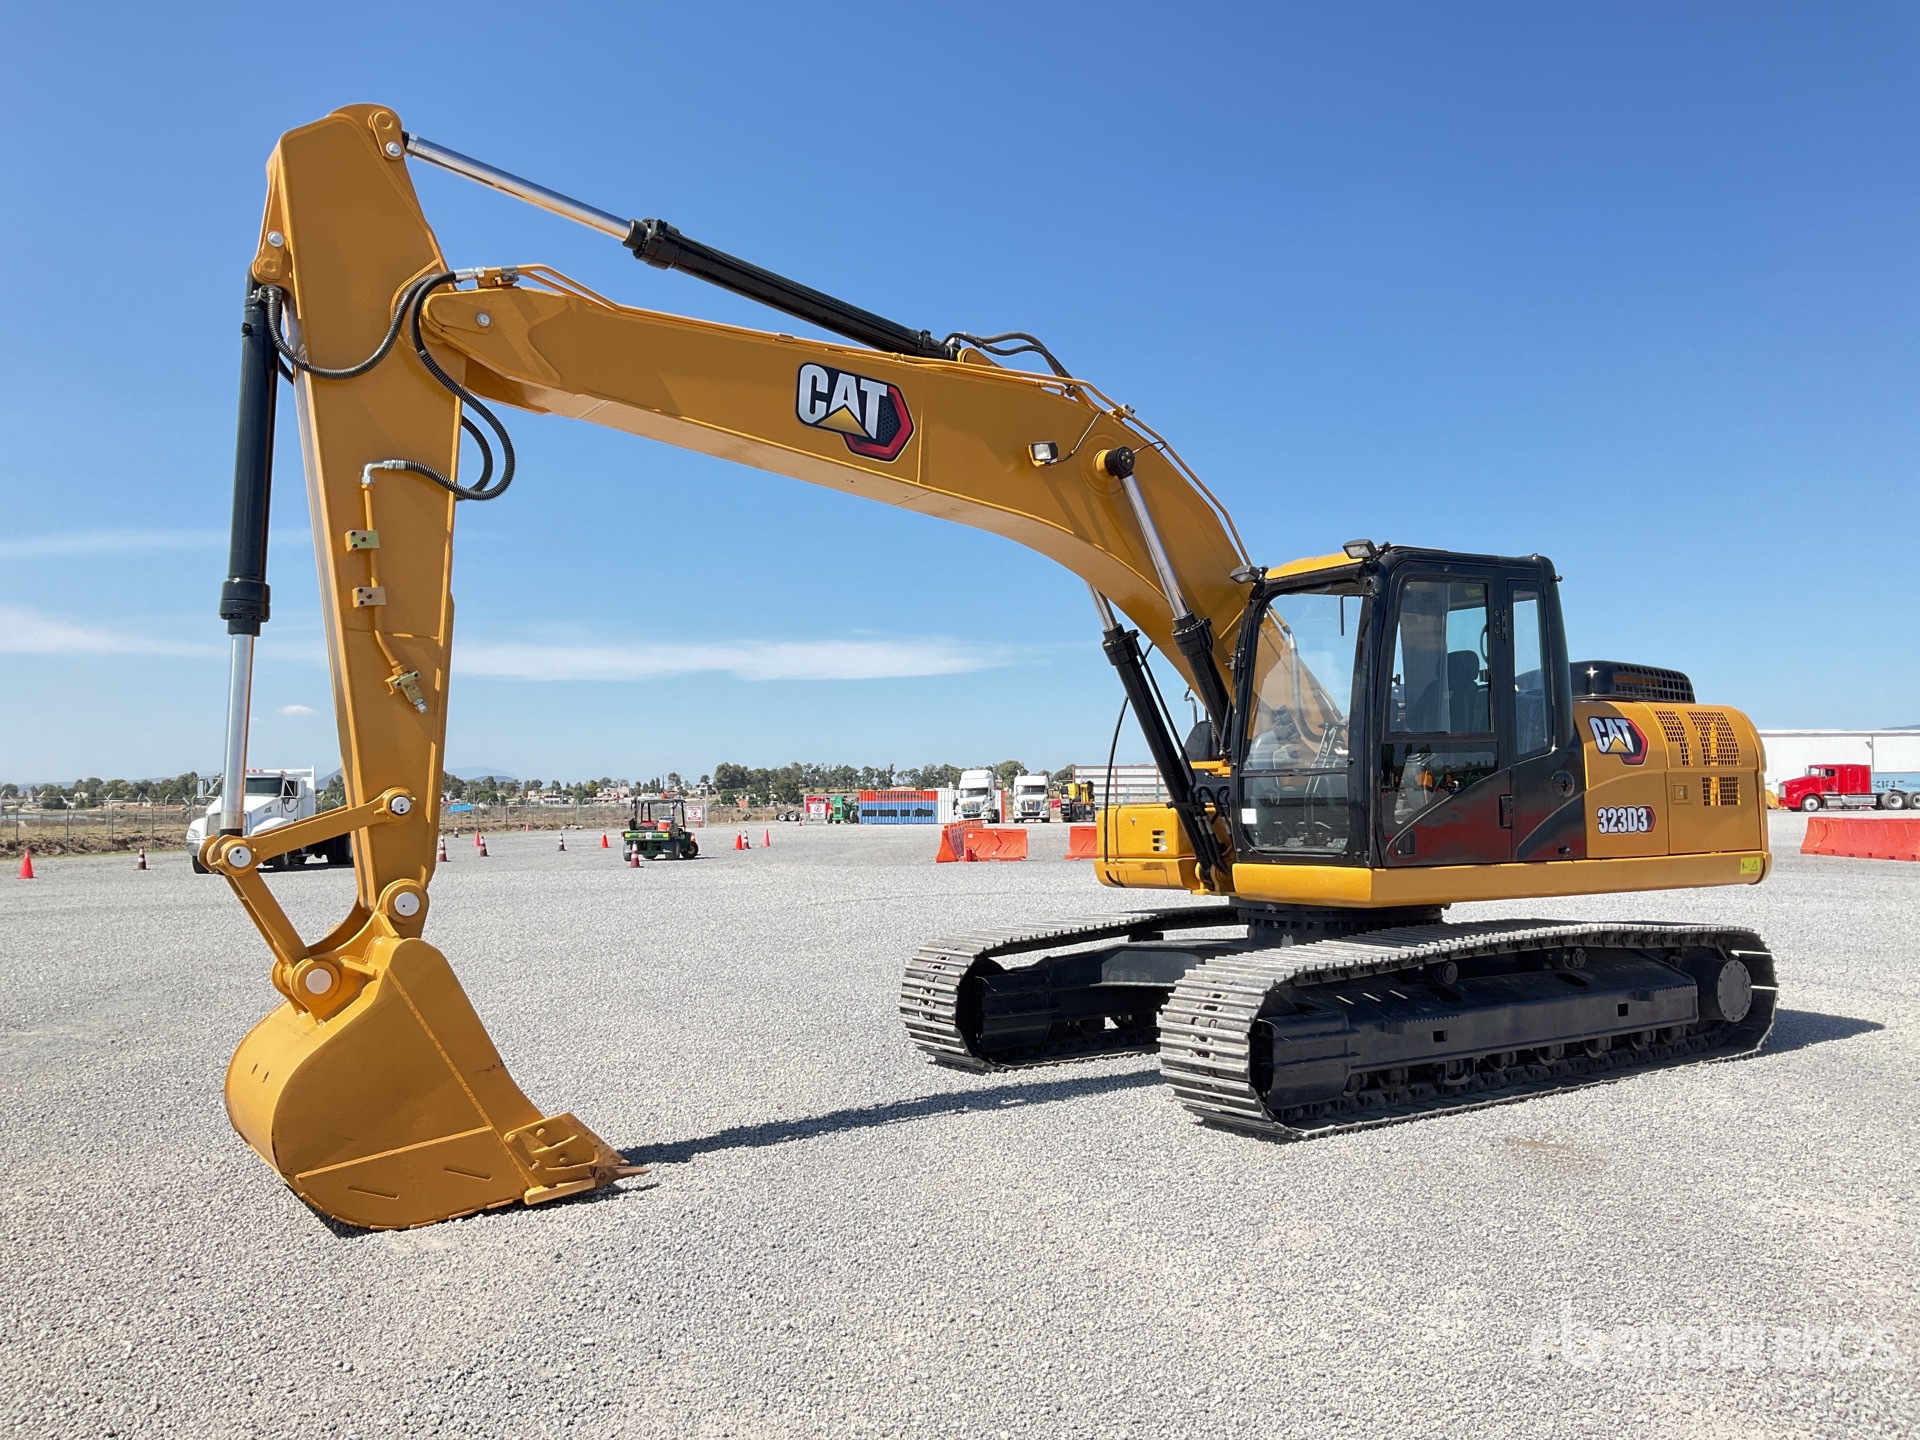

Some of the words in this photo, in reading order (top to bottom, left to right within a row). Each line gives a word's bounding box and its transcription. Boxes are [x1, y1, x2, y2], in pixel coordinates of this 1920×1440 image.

[798, 363, 888, 440] CAT
[1588, 717, 1635, 753] CAT
[1597, 806, 1649, 833] 323D3
